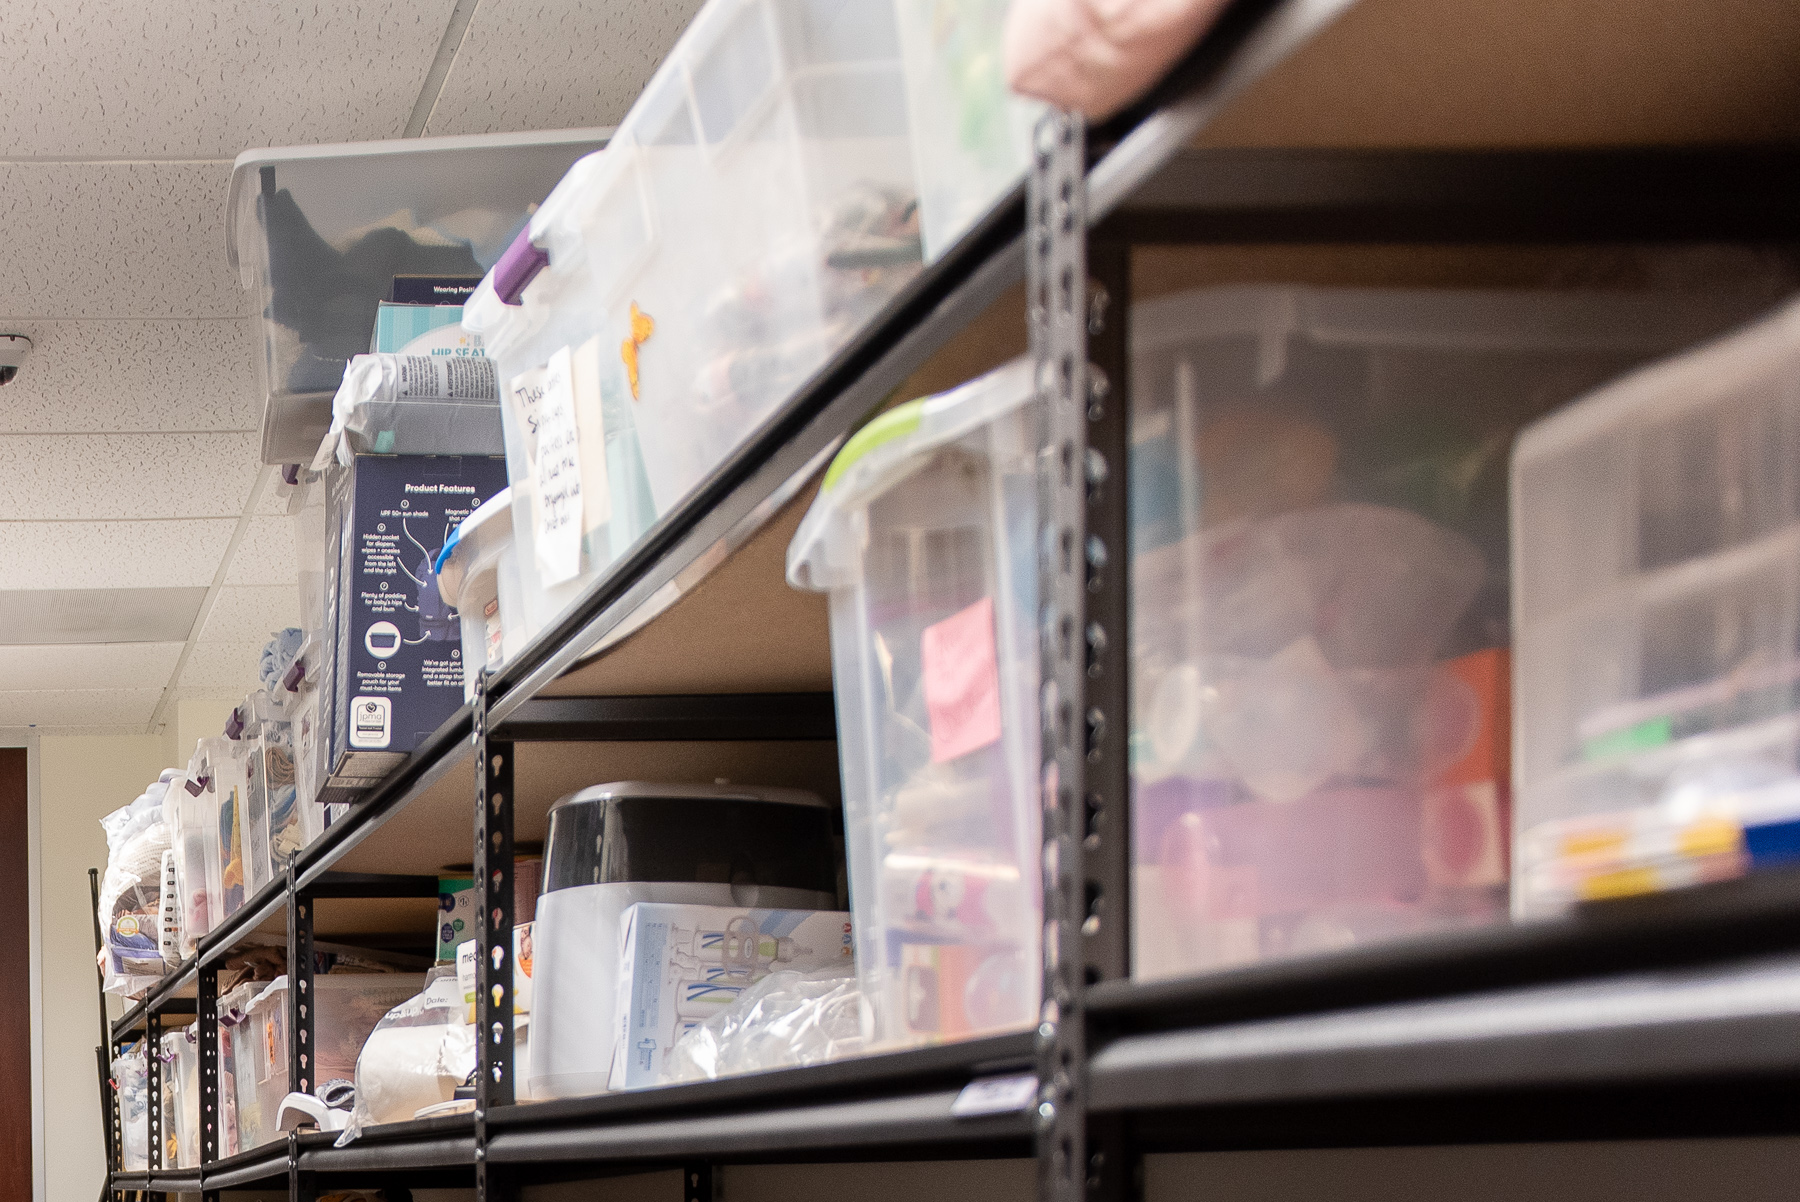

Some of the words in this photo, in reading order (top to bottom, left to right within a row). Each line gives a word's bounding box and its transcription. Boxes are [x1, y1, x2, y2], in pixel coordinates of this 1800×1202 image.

[433, 285, 458, 294] Wearing
[459, 285, 477, 294] Positi
[405, 483, 438, 493] Product
[439, 484, 476, 493] Features
[412, 510, 429, 518] shade
[445, 508, 469, 516] Magnetic
[363, 533, 381, 541] Hidden
[382, 534, 400, 542] pocket
[384, 567, 397, 575] right
[361, 591, 378, 600] Plenty
[385, 591, 406, 600] padding
[391, 599, 402, 607] hips
[439, 660, 449, 668] got
[357, 671, 385, 679] Removable
[386, 672, 406, 680] storage
[423, 672, 434, 680] and
[439, 673, 453, 681] strap
[427, 679, 443, 687] better
[359, 711, 382, 722] jpma
[426, 997, 448, 1005] Date:
